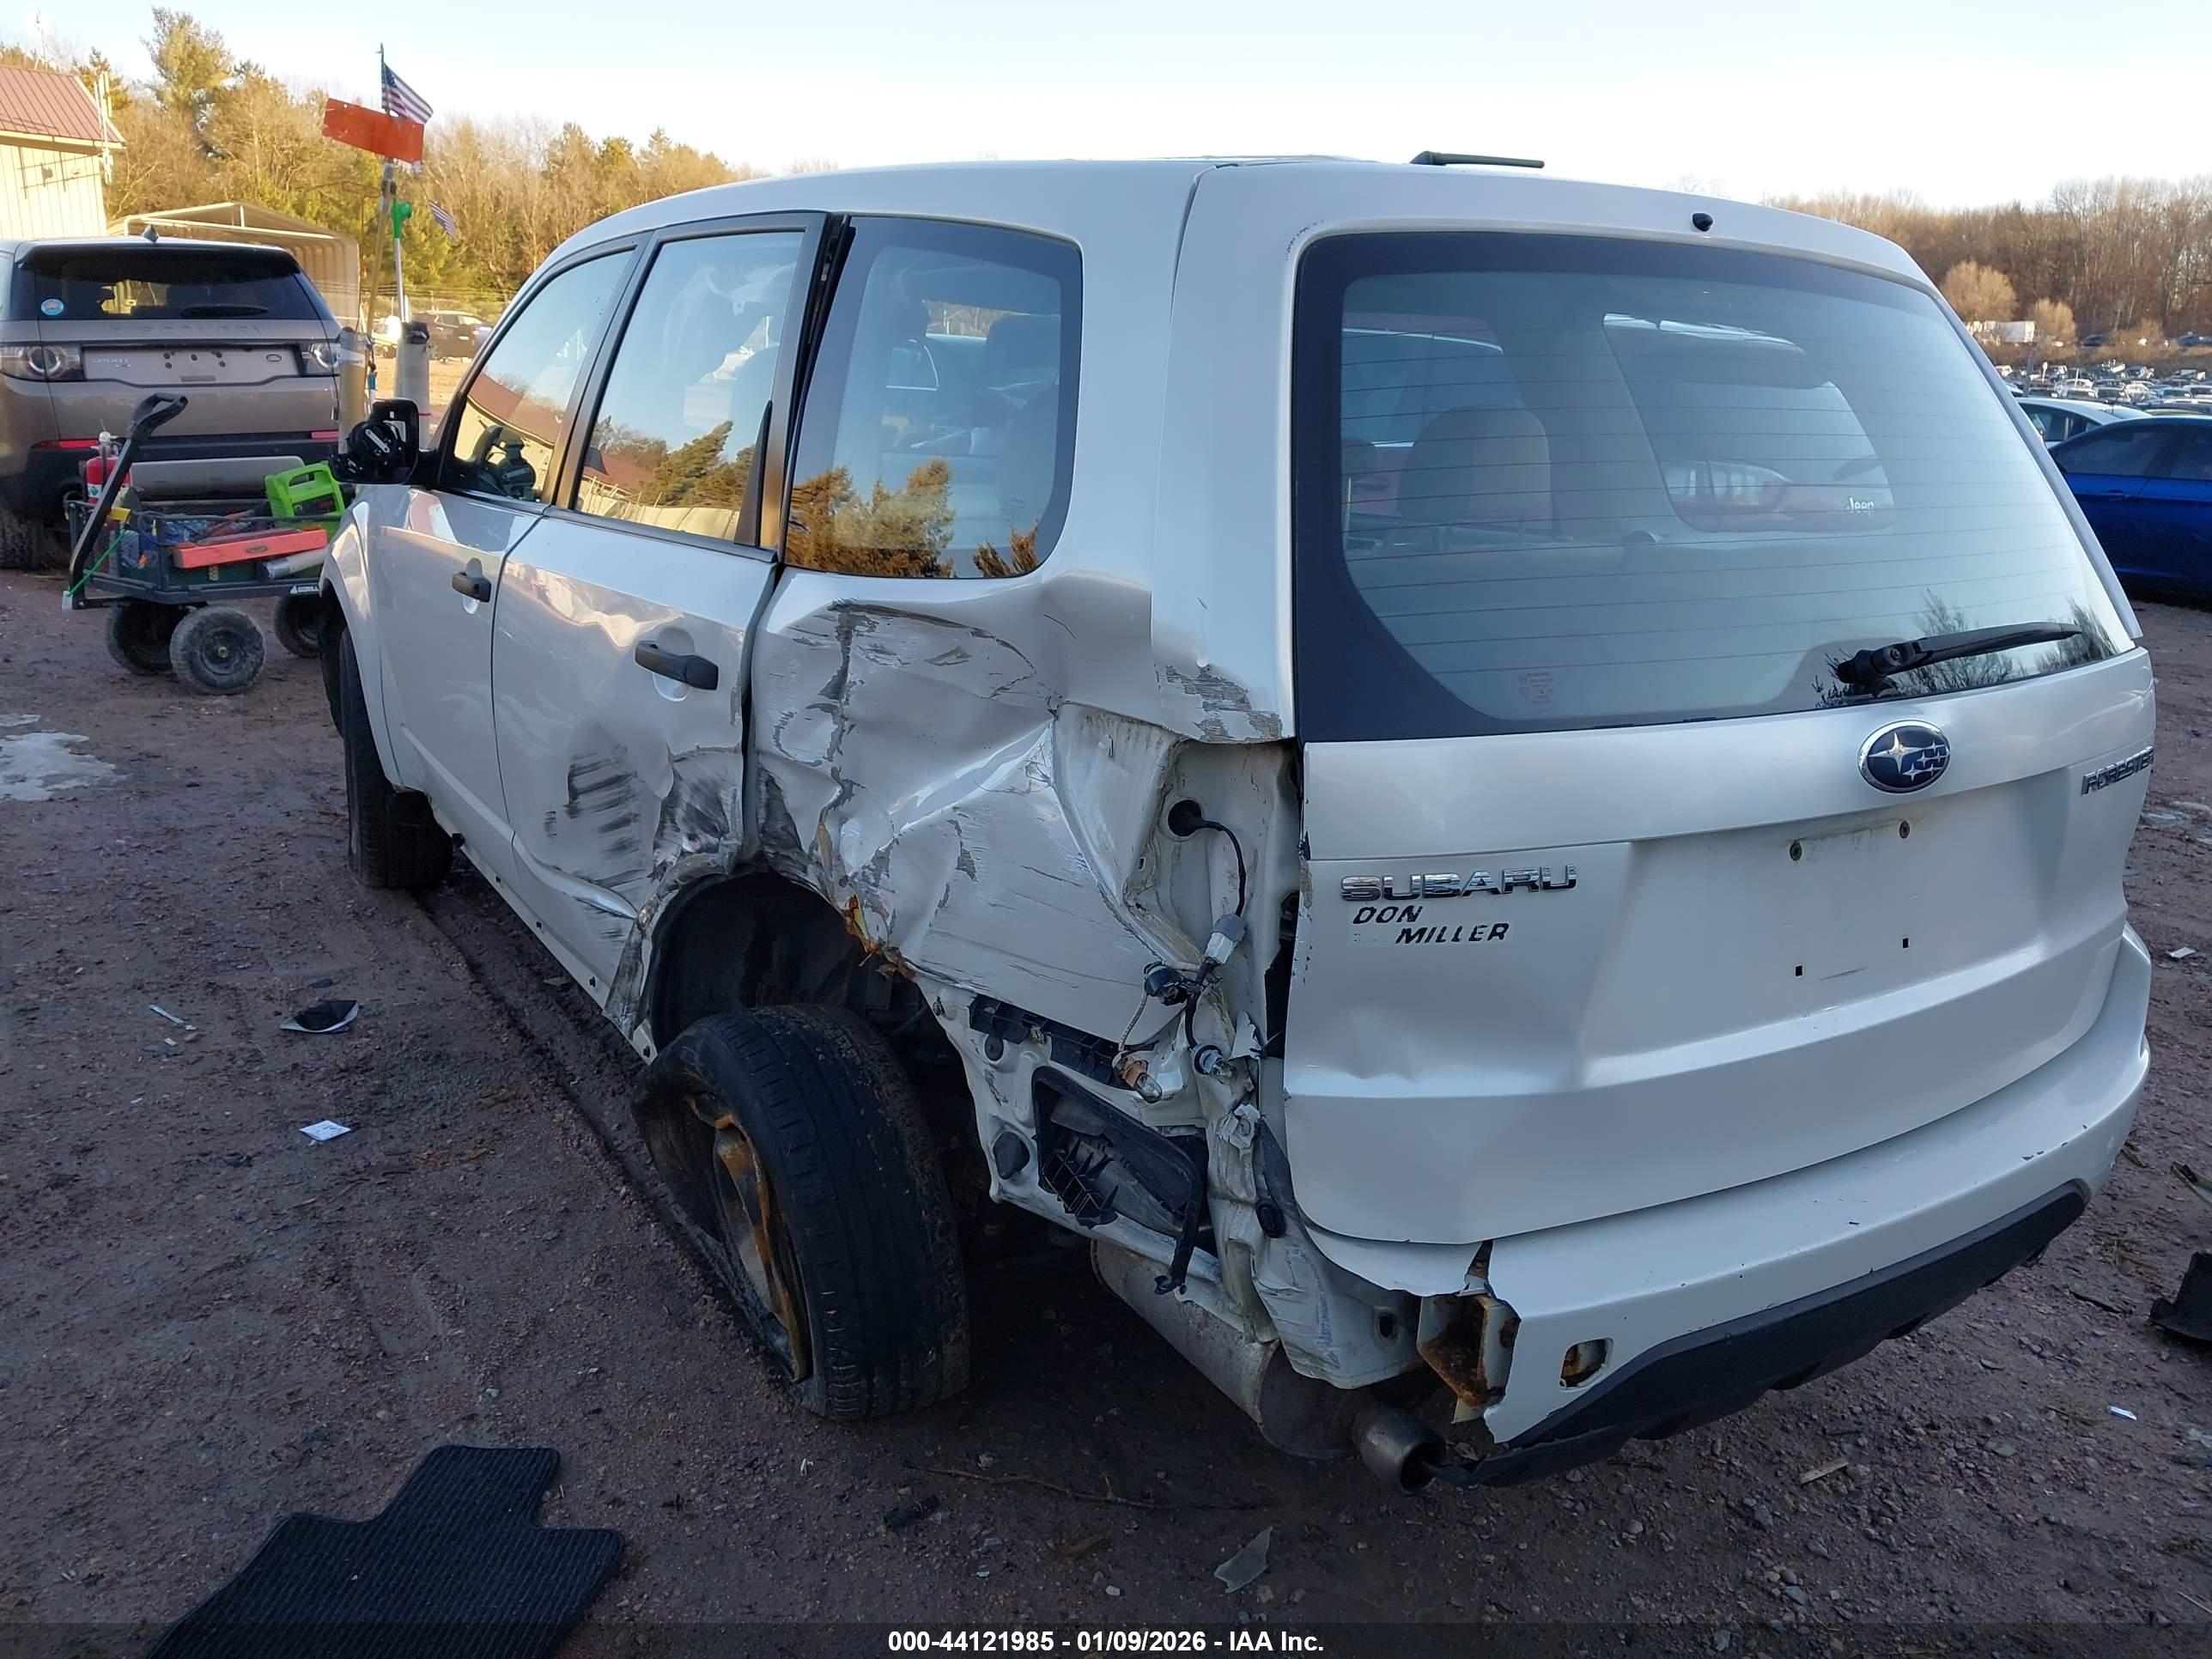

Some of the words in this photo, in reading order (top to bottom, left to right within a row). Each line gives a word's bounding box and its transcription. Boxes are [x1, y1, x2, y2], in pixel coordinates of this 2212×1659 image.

[111, 325, 261, 335] DSCOVERY
[1845, 497, 1875, 517] Jeep
[1341, 864, 1577, 901] SUBARU
[1352, 905, 1423, 924] DON
[1395, 923, 1510, 945] MILLER
